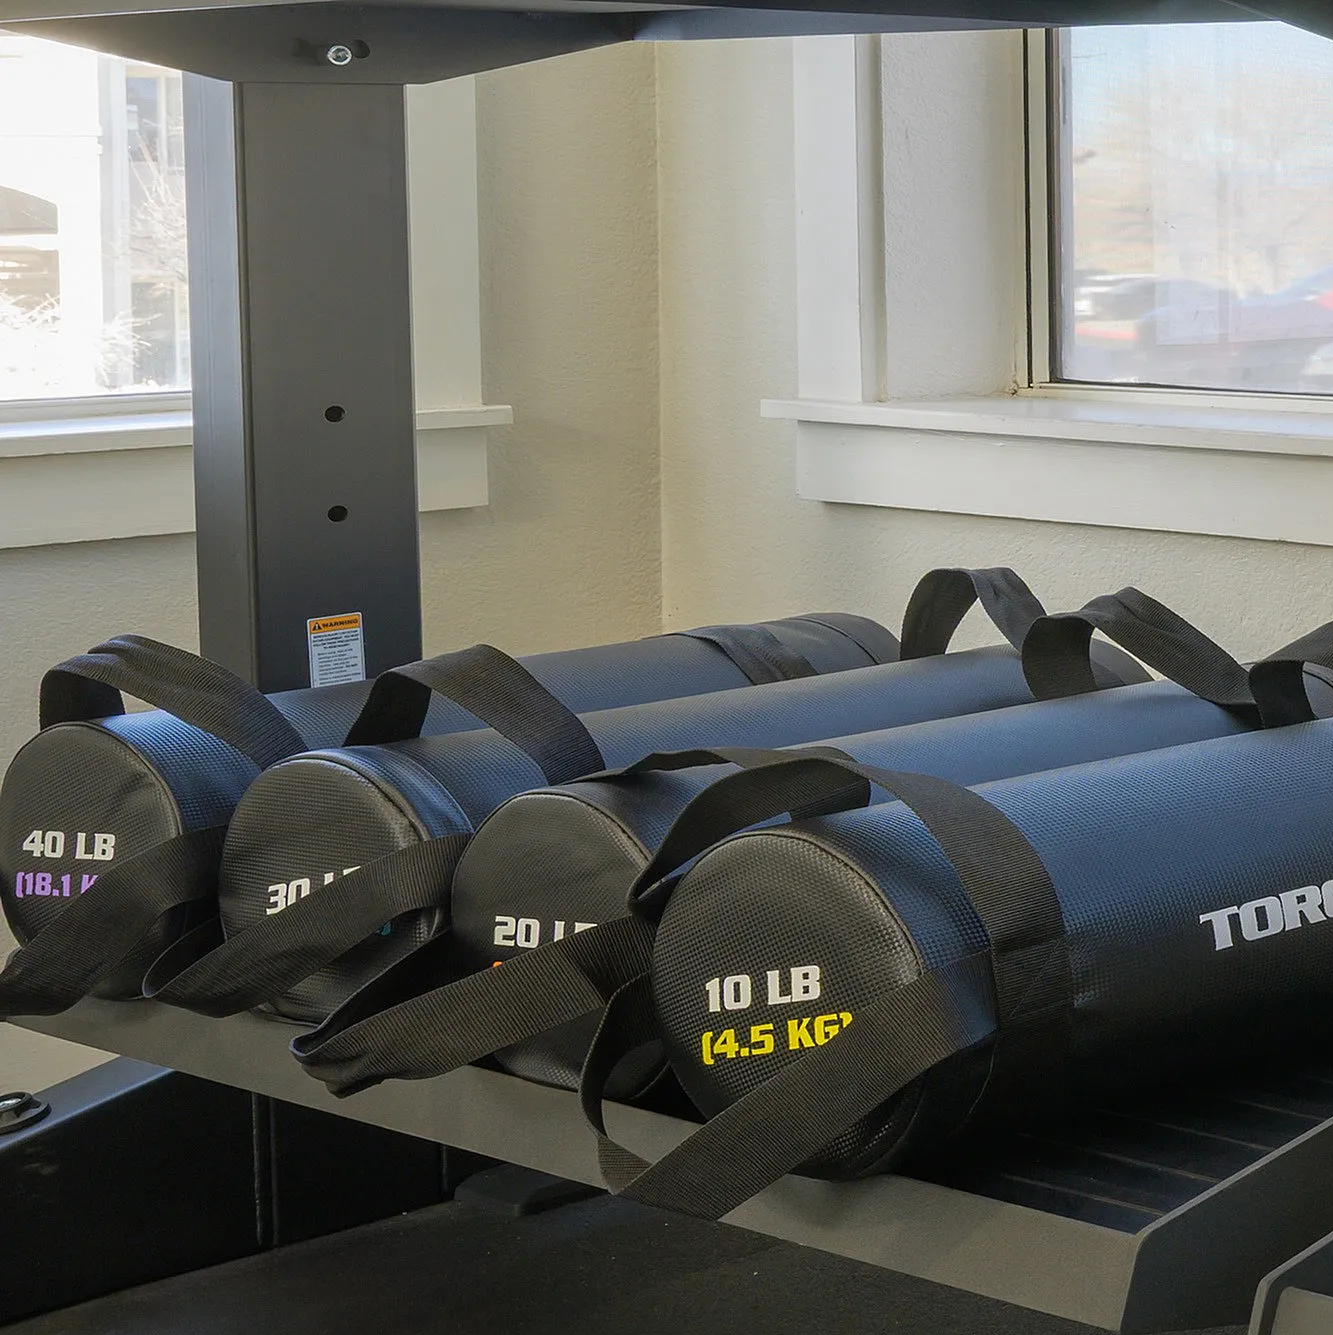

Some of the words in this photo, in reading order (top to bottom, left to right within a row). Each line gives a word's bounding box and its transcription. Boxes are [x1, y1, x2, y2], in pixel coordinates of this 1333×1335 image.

[322, 618, 358, 628] WARNING
[22, 830, 65, 858] 40
[75, 832, 116, 861] LB
[15, 872, 71, 898] (18.1
[493, 915, 541, 949] 20
[705, 974, 751, 1012] 10
[766, 965, 821, 1005] LB
[702, 1022, 775, 1065] (4.5
